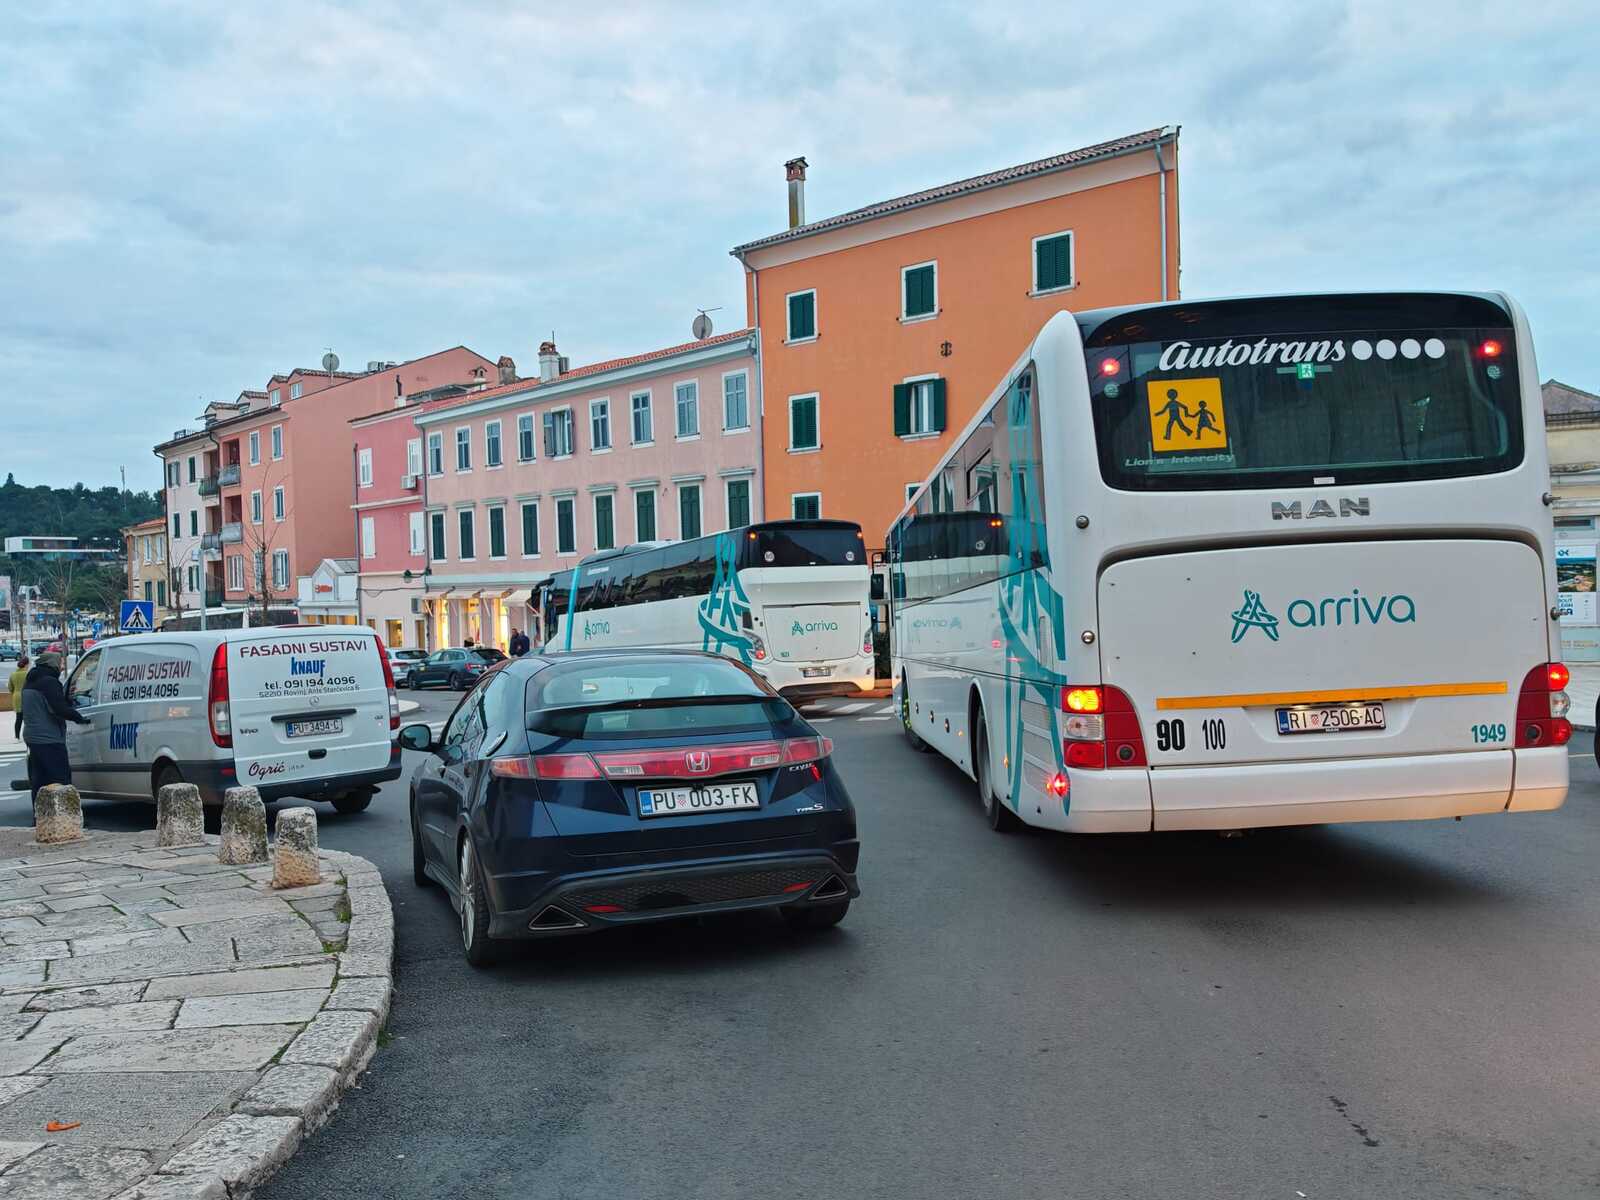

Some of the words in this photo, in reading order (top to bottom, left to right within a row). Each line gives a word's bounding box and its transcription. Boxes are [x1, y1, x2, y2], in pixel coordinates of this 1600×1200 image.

[1271, 497, 1370, 520] MAN
[1287, 588, 1416, 628] arriva
[805, 620, 838, 632] arriva
[240, 643, 306, 658] FASADNI
[309, 640, 367, 653] SUSTAVI
[107, 664, 146, 683] FASADNI
[146, 660, 192, 680] SUSTAVI
[123, 686, 137, 700] 091
[138, 685, 152, 699] 194
[154, 683, 180, 697] 4096
[264, 681, 282, 690] tel.
[284, 679, 303, 689] 091
[306, 679, 324, 688] 194
[326, 676, 356, 685] 4096
[1289, 712, 1307, 729] RI
[1320, 707, 1383, 727] 2506-AC
[1156, 719, 1186, 751] 90
[1202, 719, 1226, 750] 100
[1471, 723, 1507, 743] 1949
[653, 791, 676, 810] PU
[689, 786, 755, 808] 003-FK
